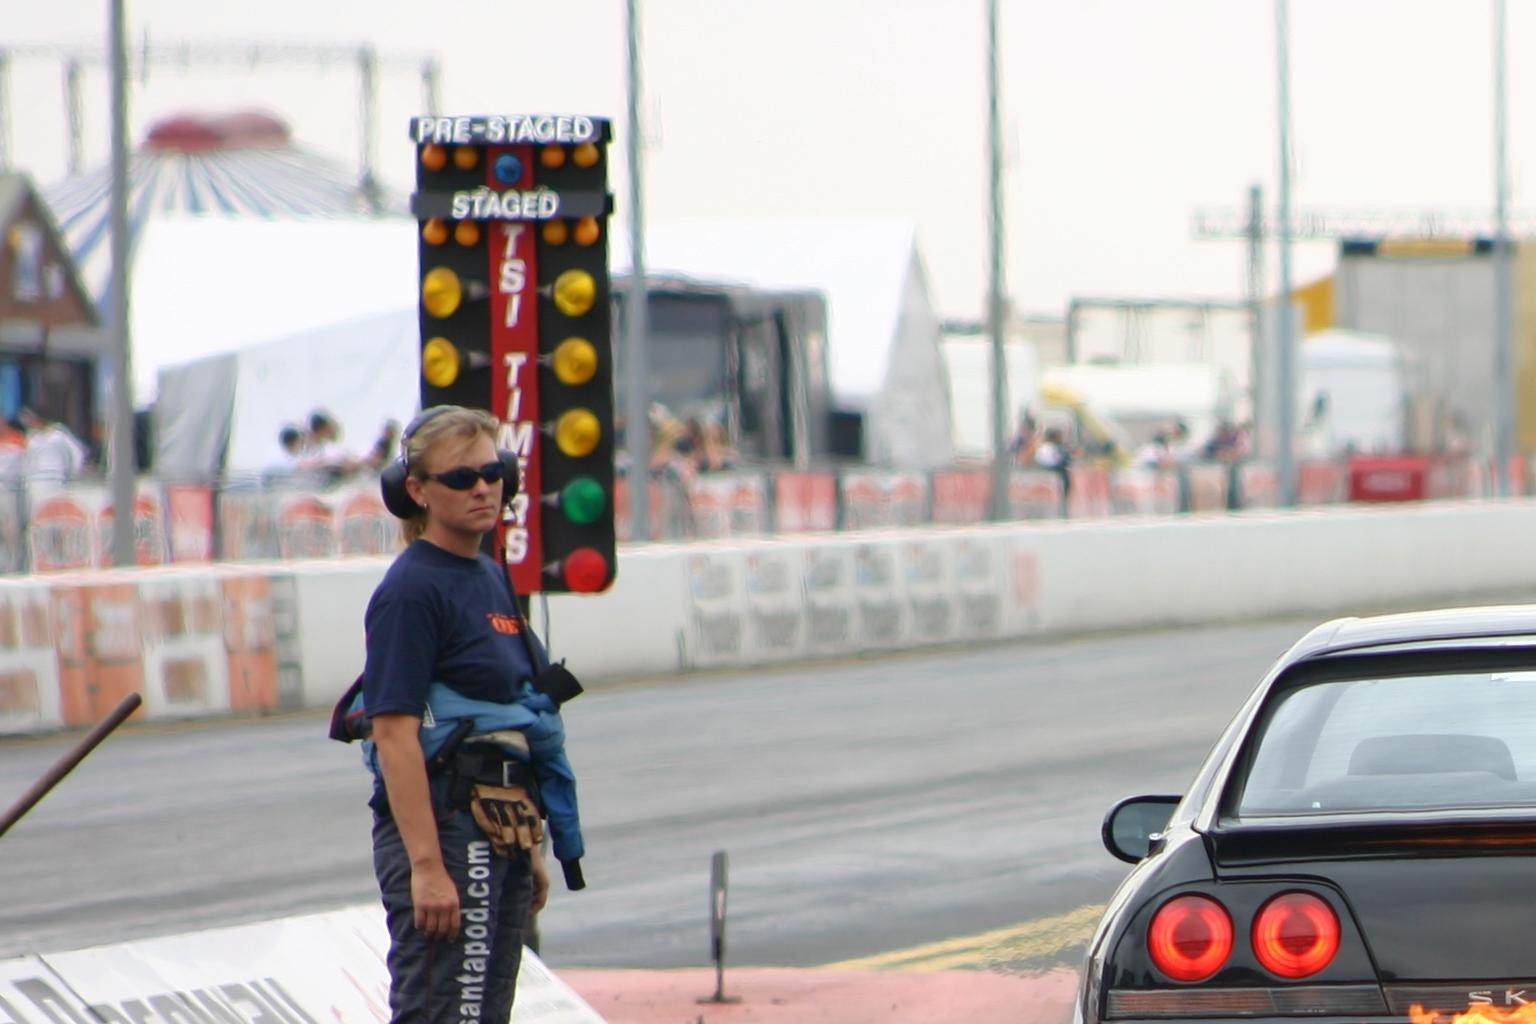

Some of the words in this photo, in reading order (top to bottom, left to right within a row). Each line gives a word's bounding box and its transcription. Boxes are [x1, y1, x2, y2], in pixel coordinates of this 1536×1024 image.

[418, 116, 594, 143] PRE-STAGED
[451, 188, 560, 219] STAGED
[499, 223, 526, 328] TSI
[498, 353, 534, 564] TIMRS
